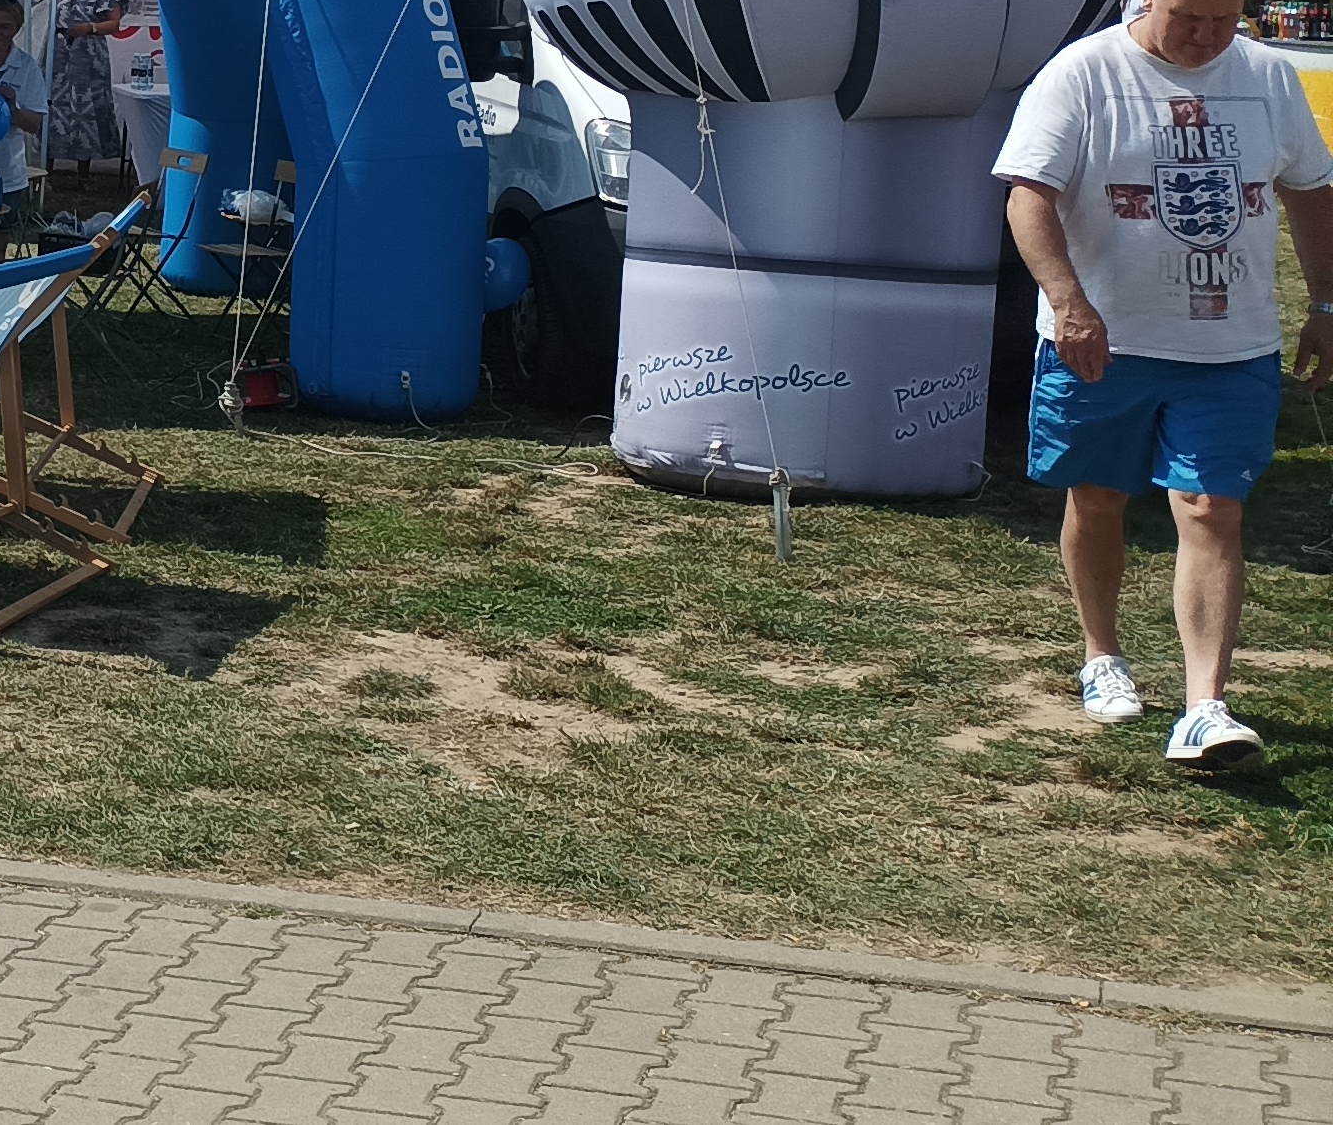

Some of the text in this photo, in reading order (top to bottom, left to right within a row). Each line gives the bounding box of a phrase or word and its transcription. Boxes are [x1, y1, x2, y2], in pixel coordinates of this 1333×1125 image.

[1148, 124, 1241, 159] THREE
[1159, 249, 1248, 286] LIONS
[639, 345, 733, 386] pierwsze
[636, 363, 851, 412] w Wielkopolsce
[894, 363, 981, 413] pierwsze
[895, 422, 918, 440] w
